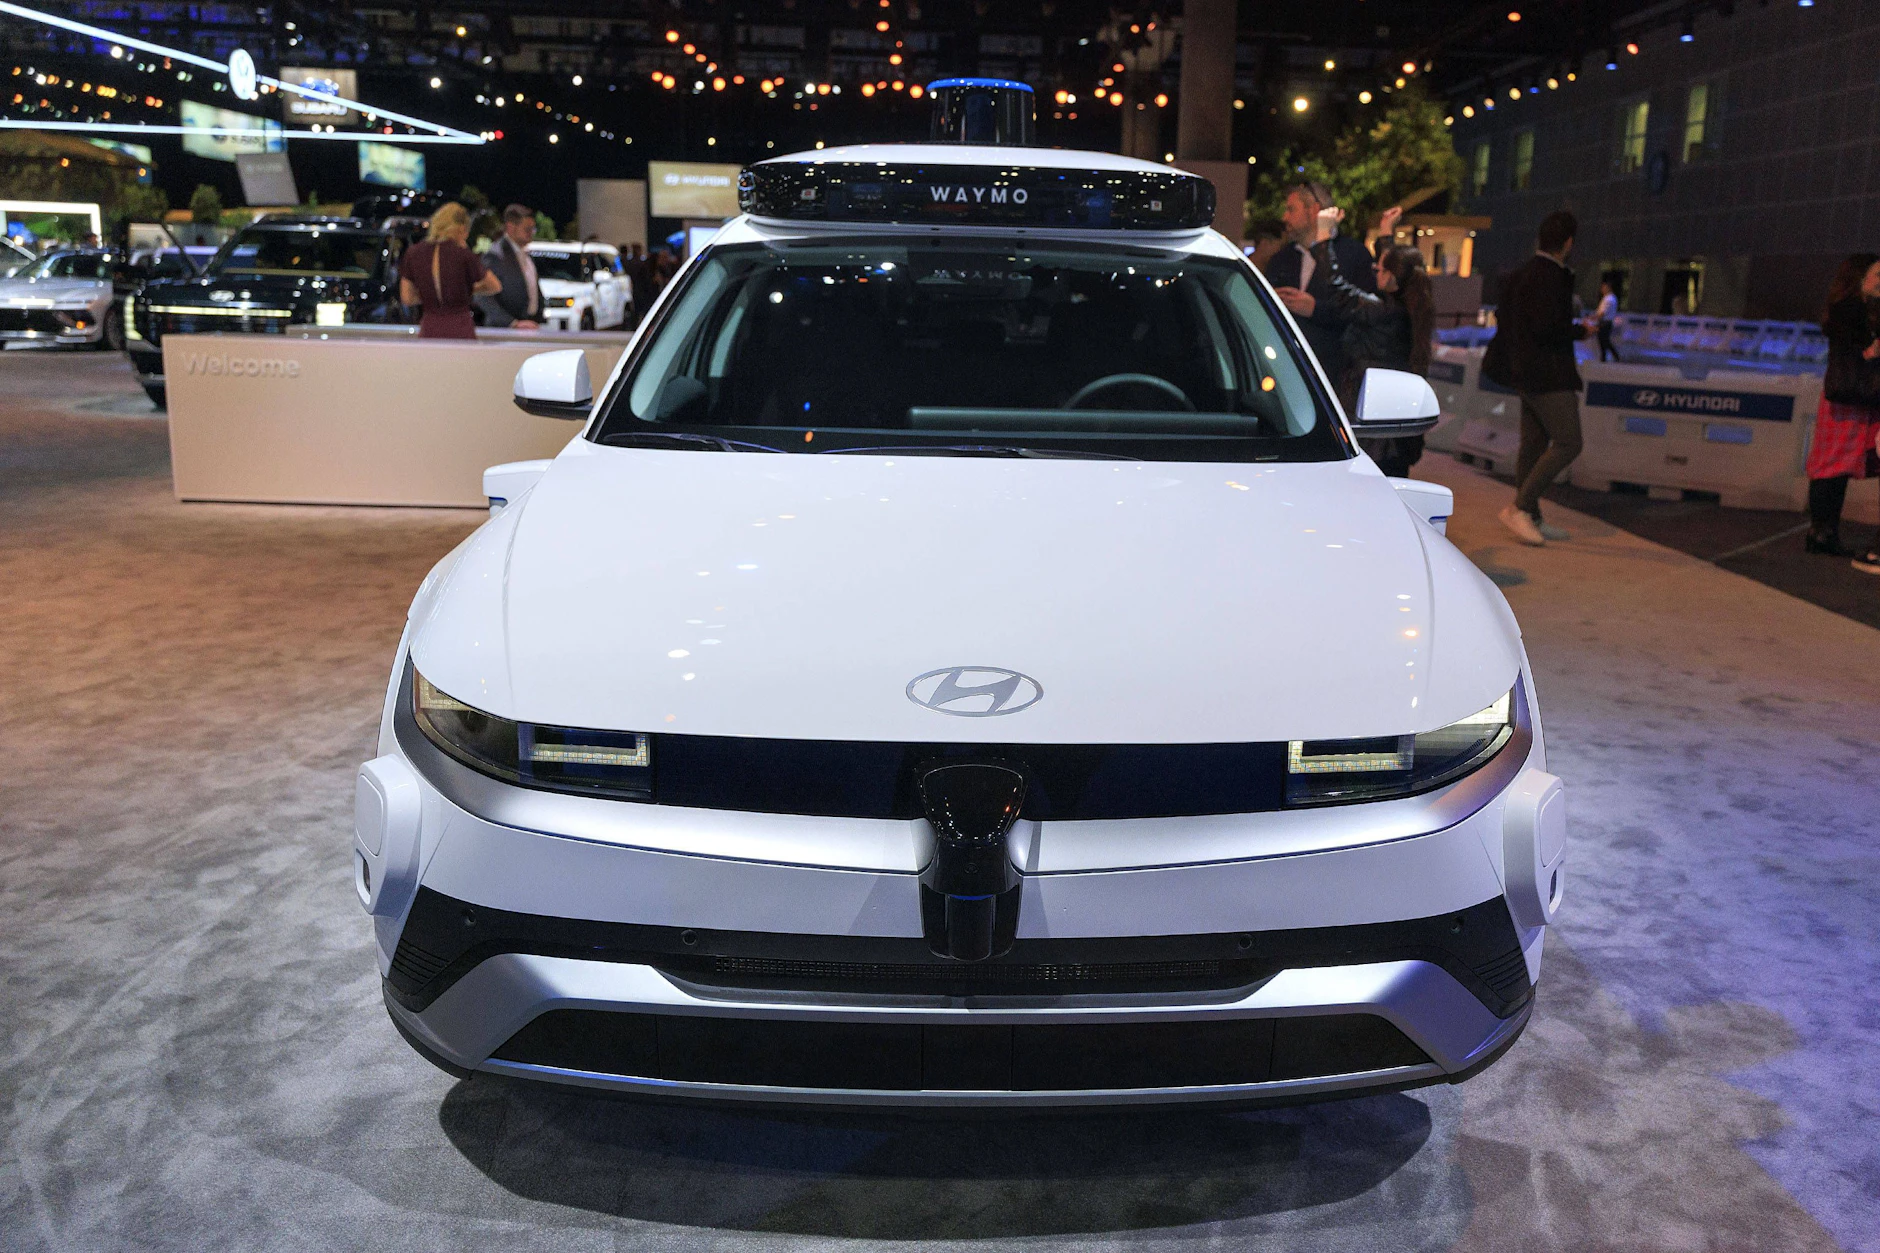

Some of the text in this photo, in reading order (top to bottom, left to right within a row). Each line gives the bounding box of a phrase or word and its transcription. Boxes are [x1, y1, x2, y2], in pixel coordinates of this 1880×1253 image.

[930, 186, 1028, 204] WAYMO
[181, 353, 301, 379] Welcome
[1663, 393, 1740, 412] HYUNDAI
